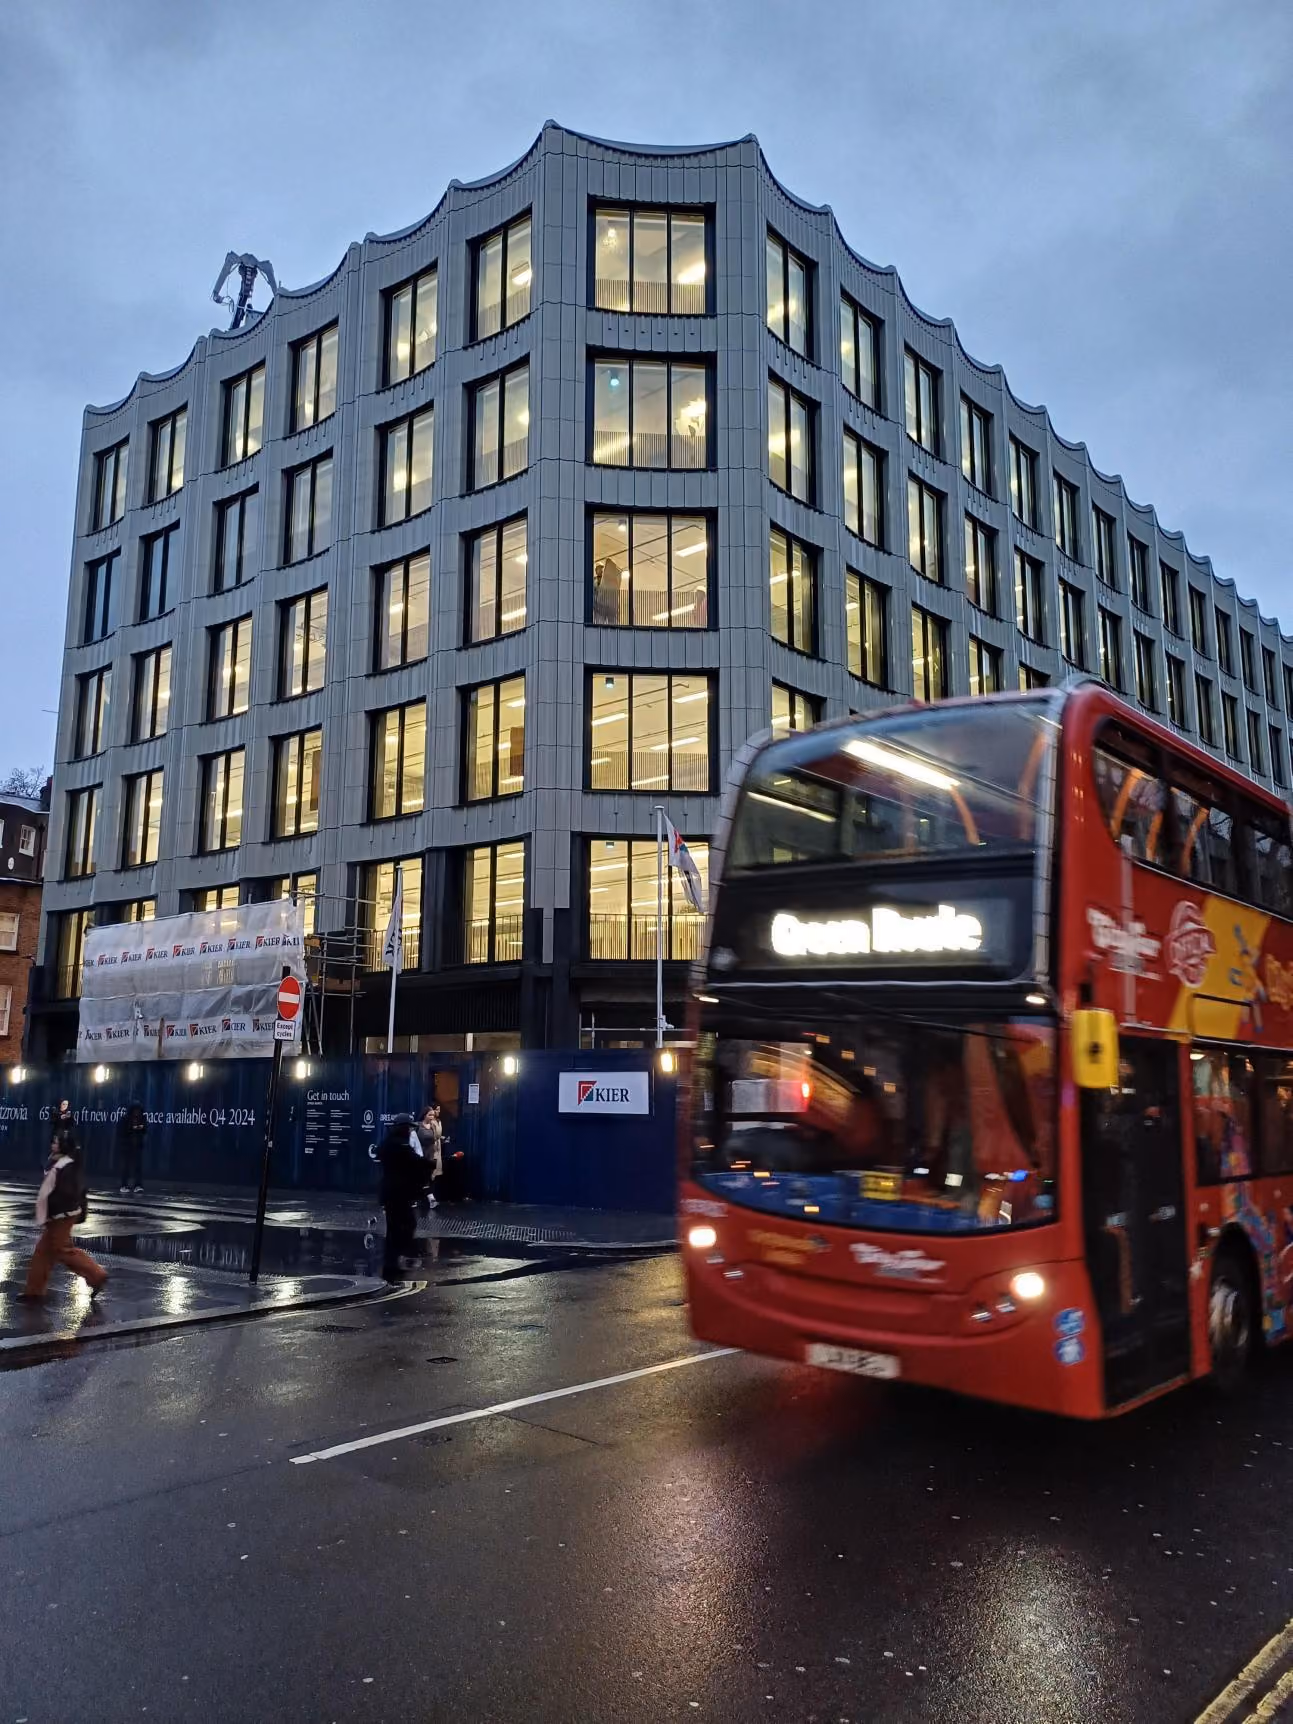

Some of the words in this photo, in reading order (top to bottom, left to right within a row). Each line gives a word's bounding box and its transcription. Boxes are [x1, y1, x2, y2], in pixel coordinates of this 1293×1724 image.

[260, 1022, 275, 1031] KIE
[277, 1022, 293, 1030] Except
[307, 1090, 319, 1101] Get
[329, 1090, 350, 1101] touch
[595, 1087, 630, 1103] KIER
[91, 1109, 108, 1122] new
[166, 1107, 206, 1124] available
[209, 1108, 226, 1127] Q4
[228, 1108, 256, 1126] 2024
